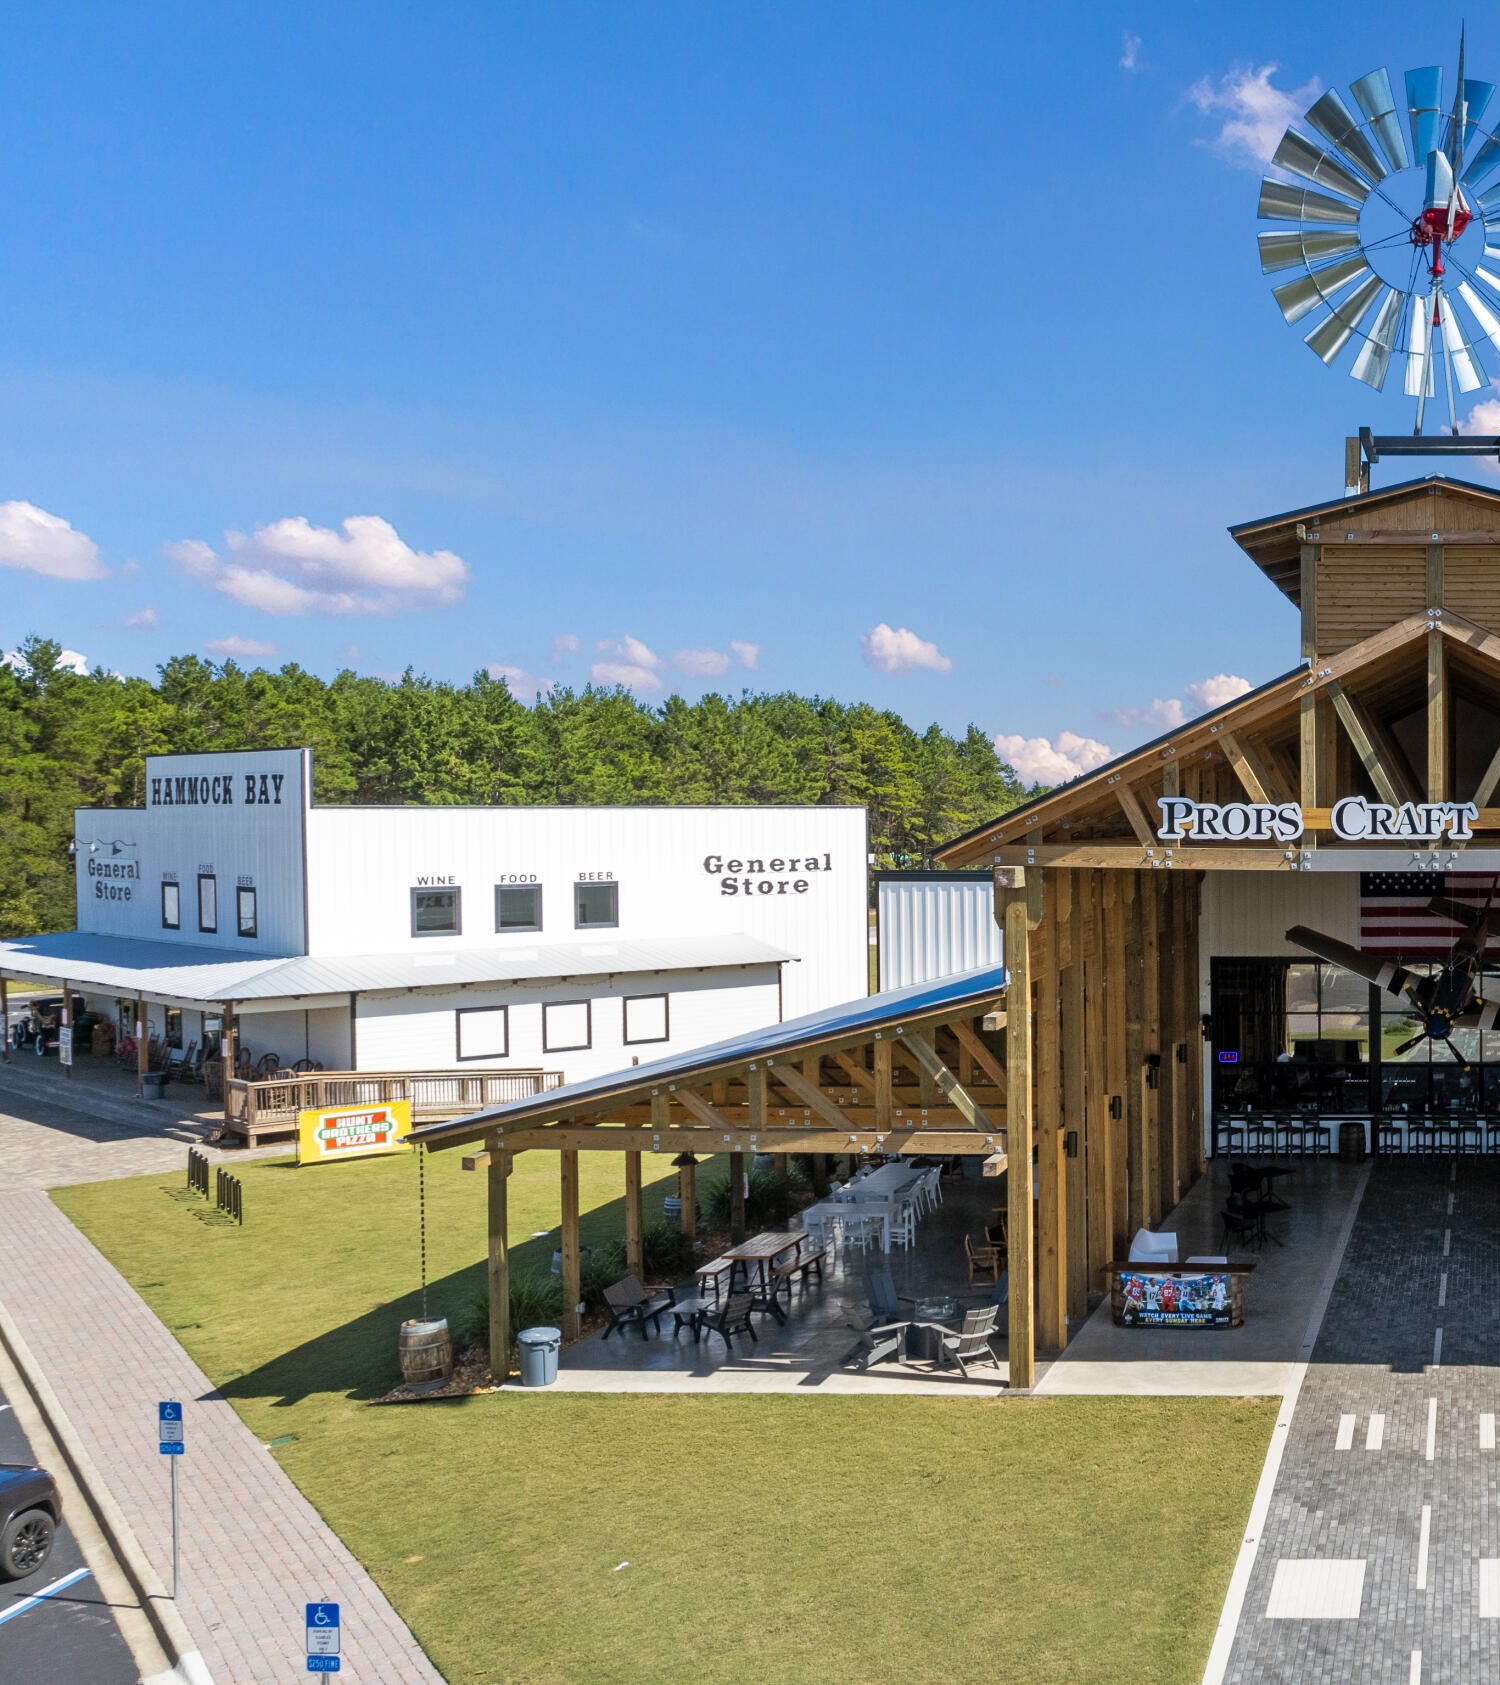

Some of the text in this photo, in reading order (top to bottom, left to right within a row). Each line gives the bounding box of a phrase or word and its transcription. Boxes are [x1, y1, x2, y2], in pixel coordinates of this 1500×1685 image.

[152, 774, 284, 805] HAMMOCK BAY
[1159, 801, 1300, 836] PROPS
[1334, 799, 1475, 836] CRAFT
[88, 858, 140, 880] General
[198, 864, 214, 874] FOOD
[703, 853, 833, 875] General
[163, 872, 177, 882] WINE
[237, 876, 253, 887] BEER
[417, 875, 456, 886] WINE
[500, 874, 537, 883] FOOD
[579, 872, 614, 881] BEER
[95, 881, 131, 901] Store
[720, 877, 809, 896] Store
[336, 1115, 375, 1128] HUNT
[321, 1124, 389, 1139] BROTHERS
[336, 1133, 376, 1147] PIZZA
